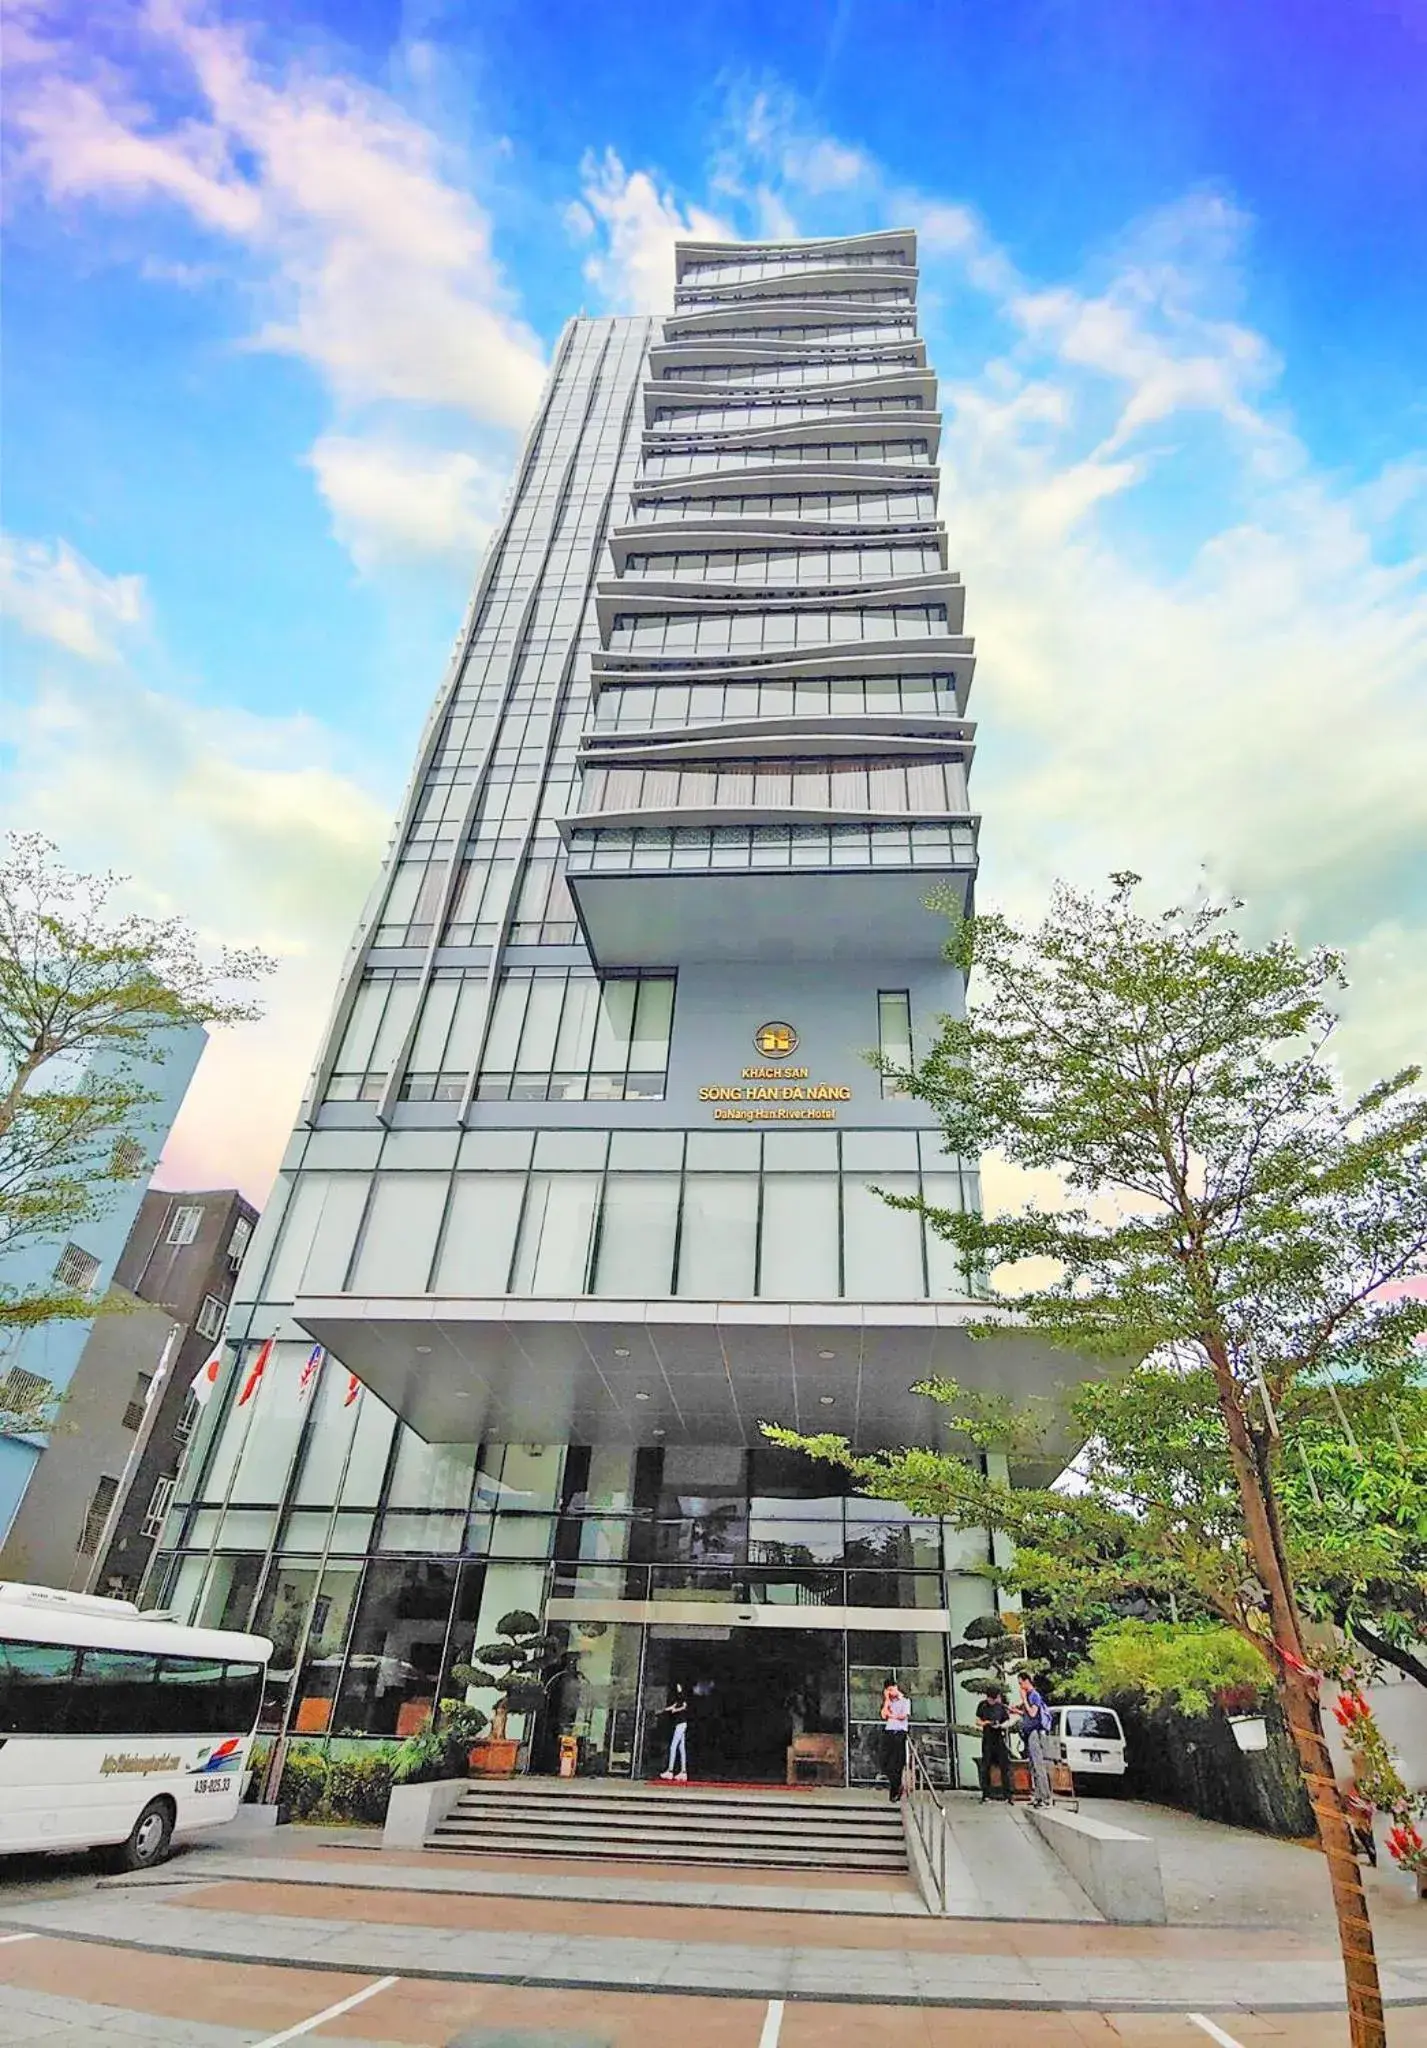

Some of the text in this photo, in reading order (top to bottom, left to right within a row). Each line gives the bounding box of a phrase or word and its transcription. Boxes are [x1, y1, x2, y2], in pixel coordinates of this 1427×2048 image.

[756, 1108, 776, 1119] Han
[778, 1108, 805, 1119] River
[807, 1108, 836, 1119] Hotel
